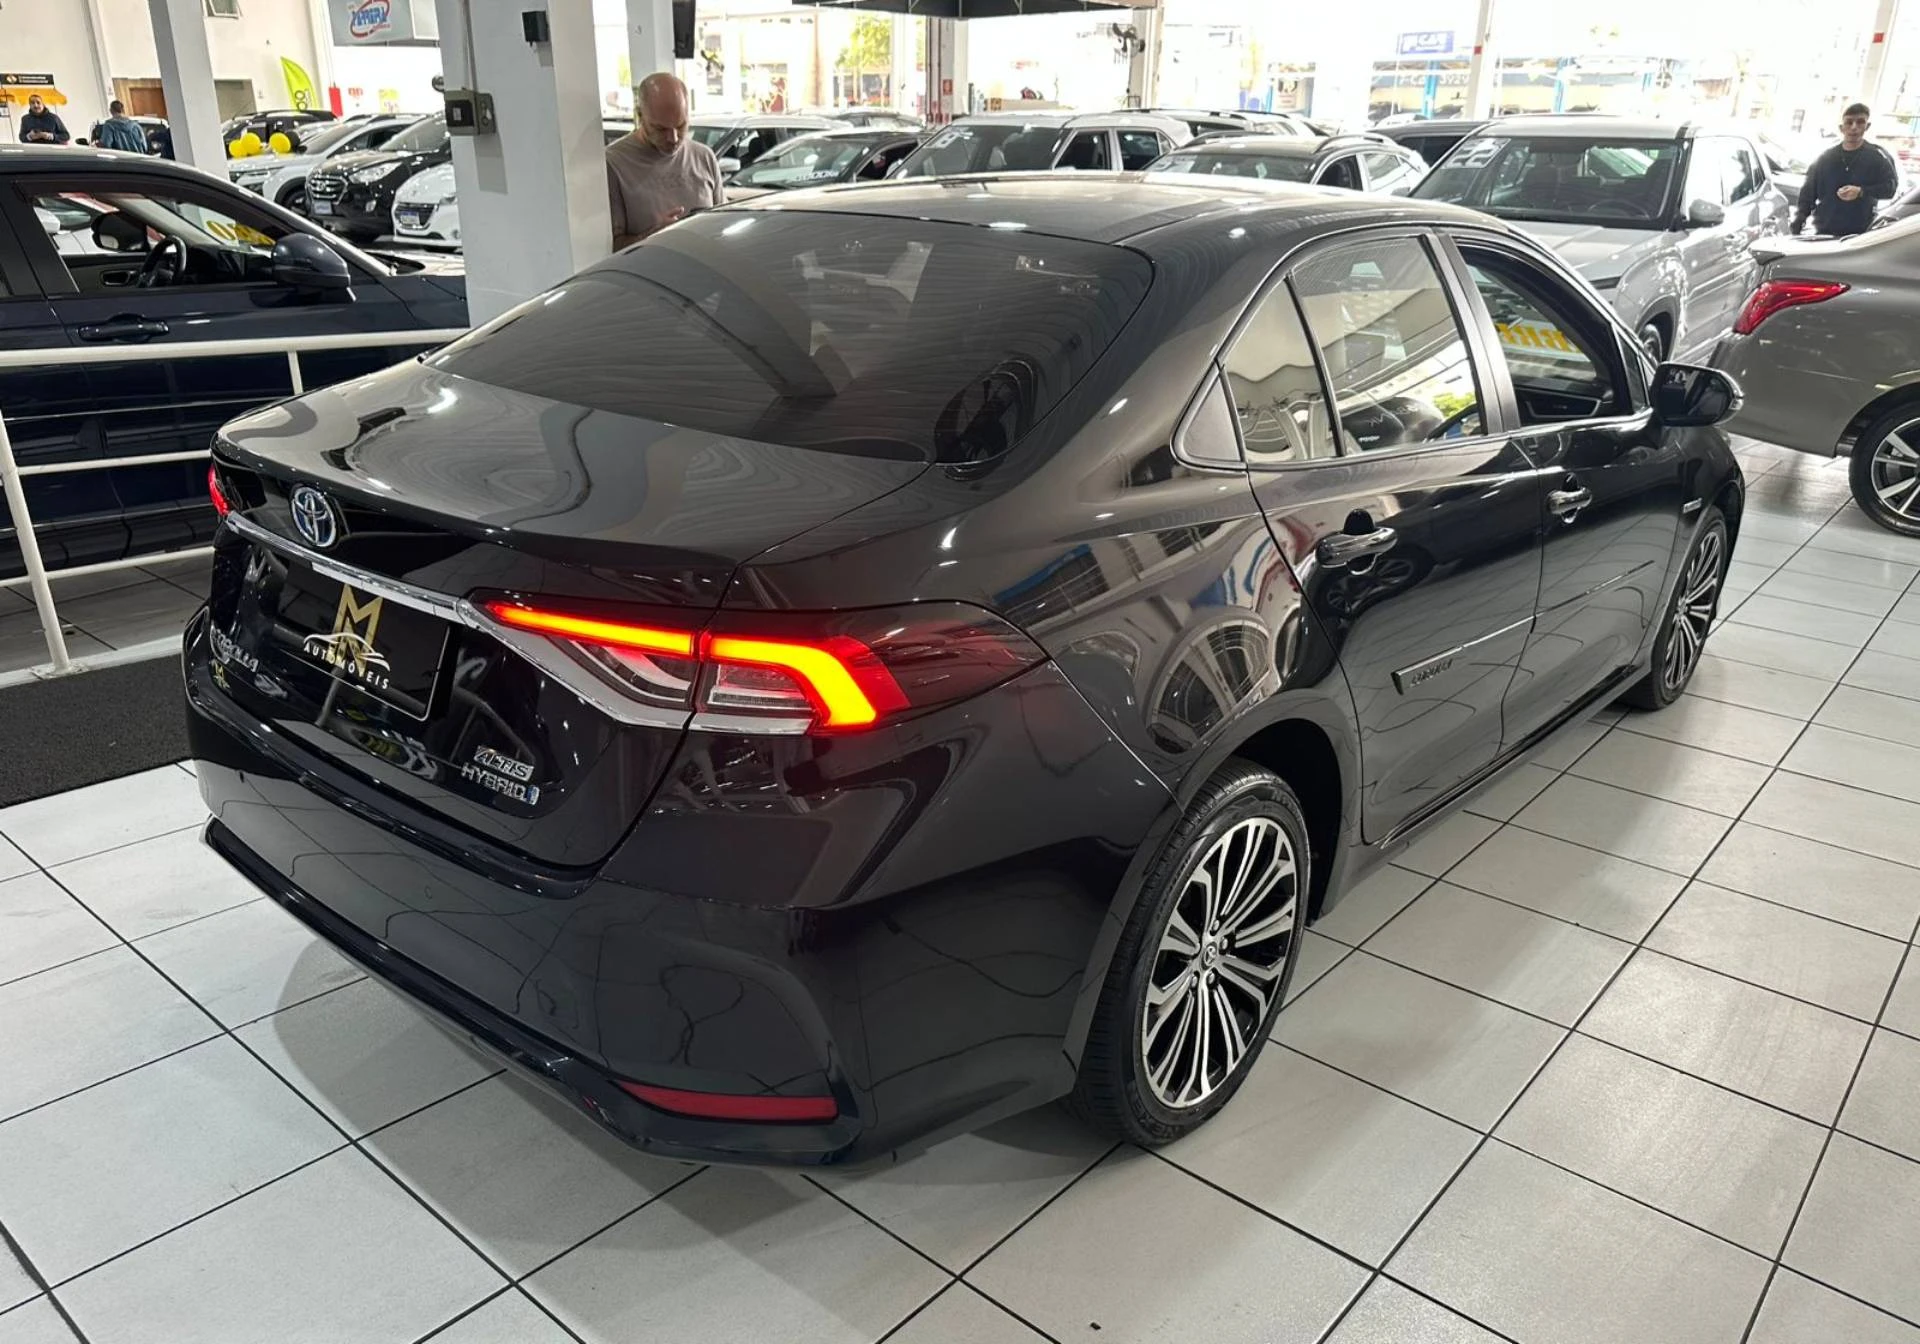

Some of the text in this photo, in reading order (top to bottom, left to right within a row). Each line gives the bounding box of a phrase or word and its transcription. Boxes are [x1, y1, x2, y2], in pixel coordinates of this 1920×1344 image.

[1443, 138, 1507, 168] 22
[473, 746, 534, 781] ALTIS
[461, 762, 529, 802] HYBRID
